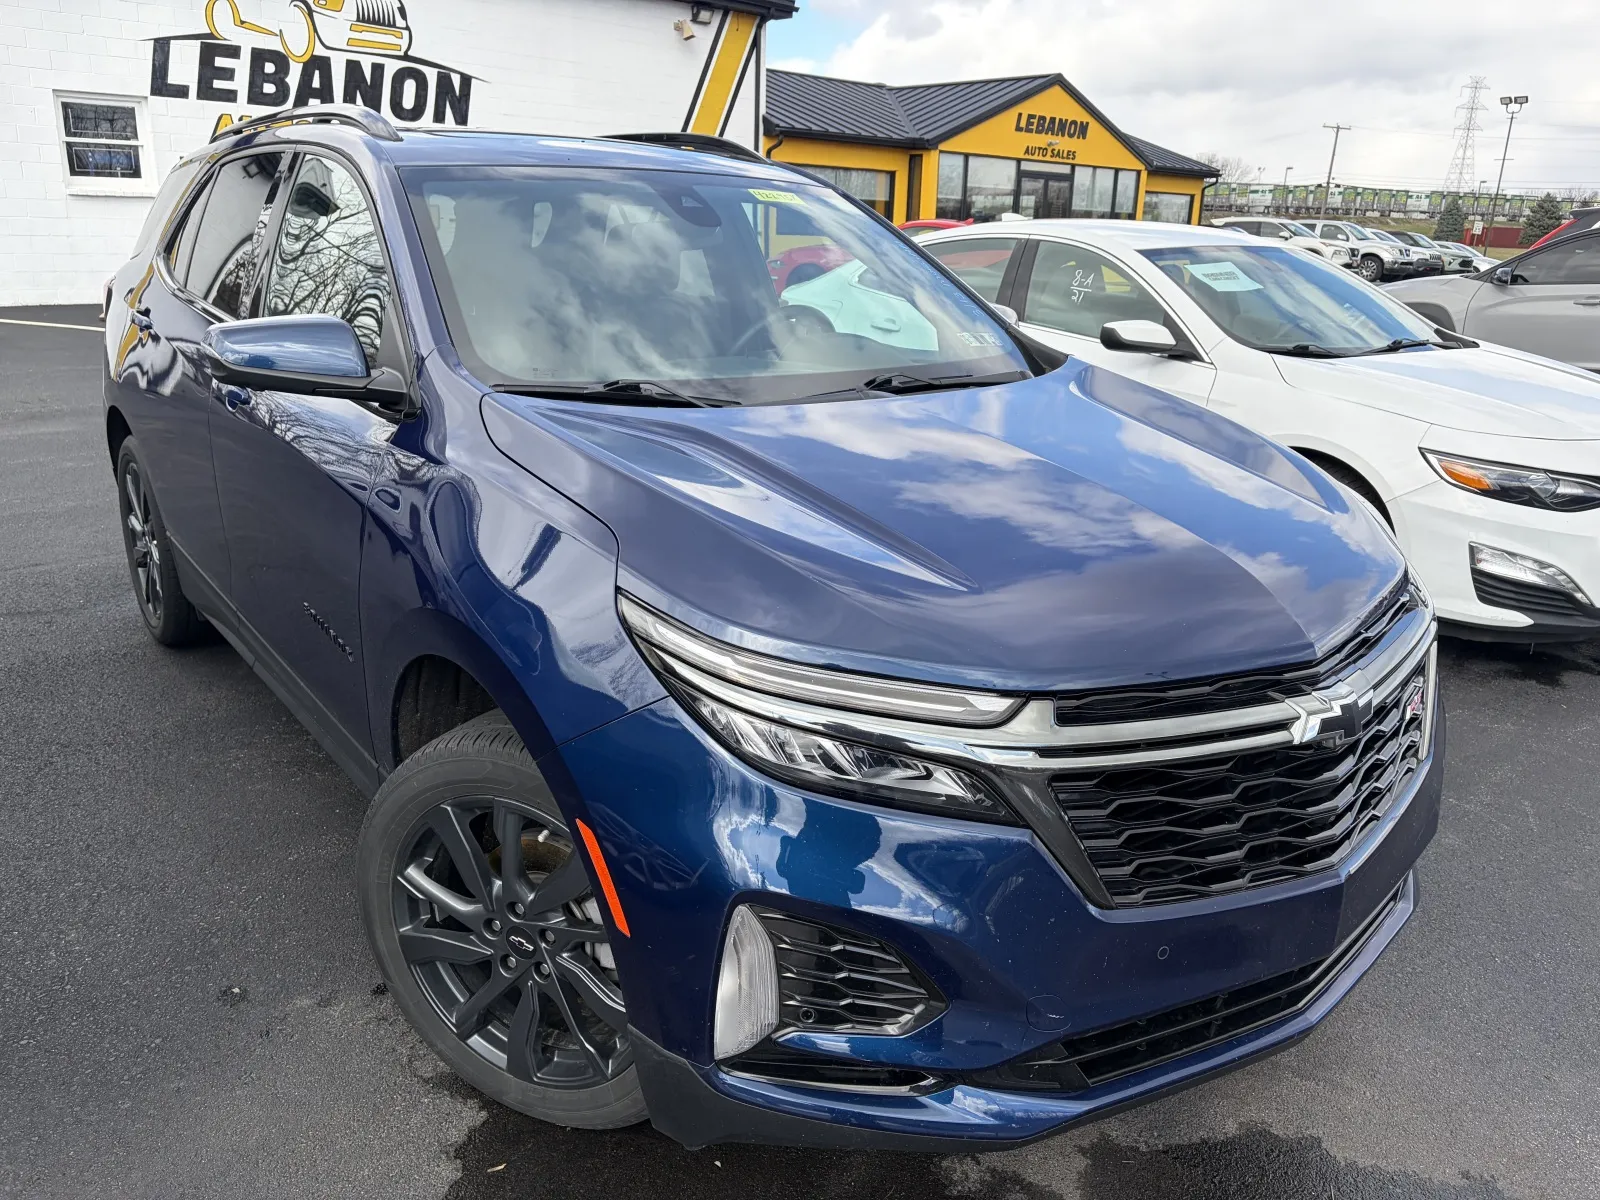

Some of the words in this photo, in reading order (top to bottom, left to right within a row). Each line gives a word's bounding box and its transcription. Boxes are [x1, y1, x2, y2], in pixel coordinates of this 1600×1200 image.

[150, 39, 473, 126] LEBANON
[1014, 112, 1090, 140] LEBANON
[1024, 145, 1049, 158] AUTO
[1050, 148, 1077, 160] SALES
